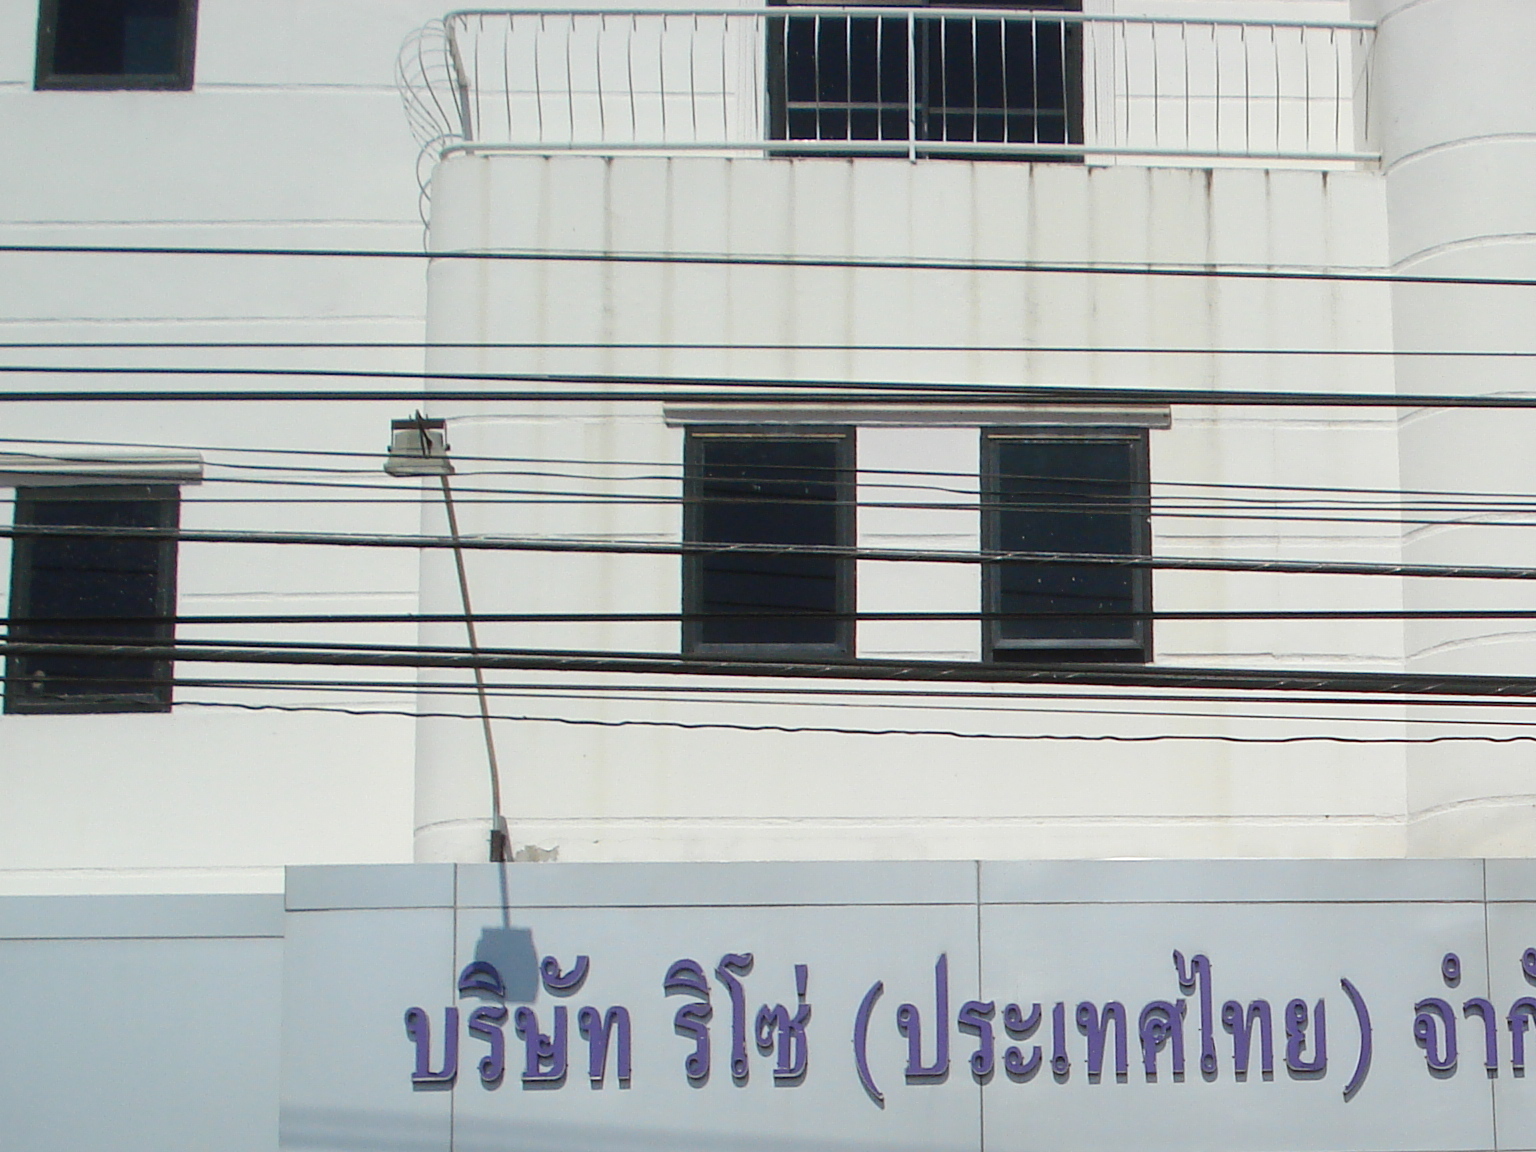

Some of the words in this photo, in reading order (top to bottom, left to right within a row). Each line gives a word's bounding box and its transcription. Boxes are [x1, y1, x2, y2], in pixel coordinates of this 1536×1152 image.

[403, 954, 633, 1080] บริษัท
[663, 952, 811, 1079] ริโซ่
[852, 949, 1373, 1092] (ประเทศไทย)
